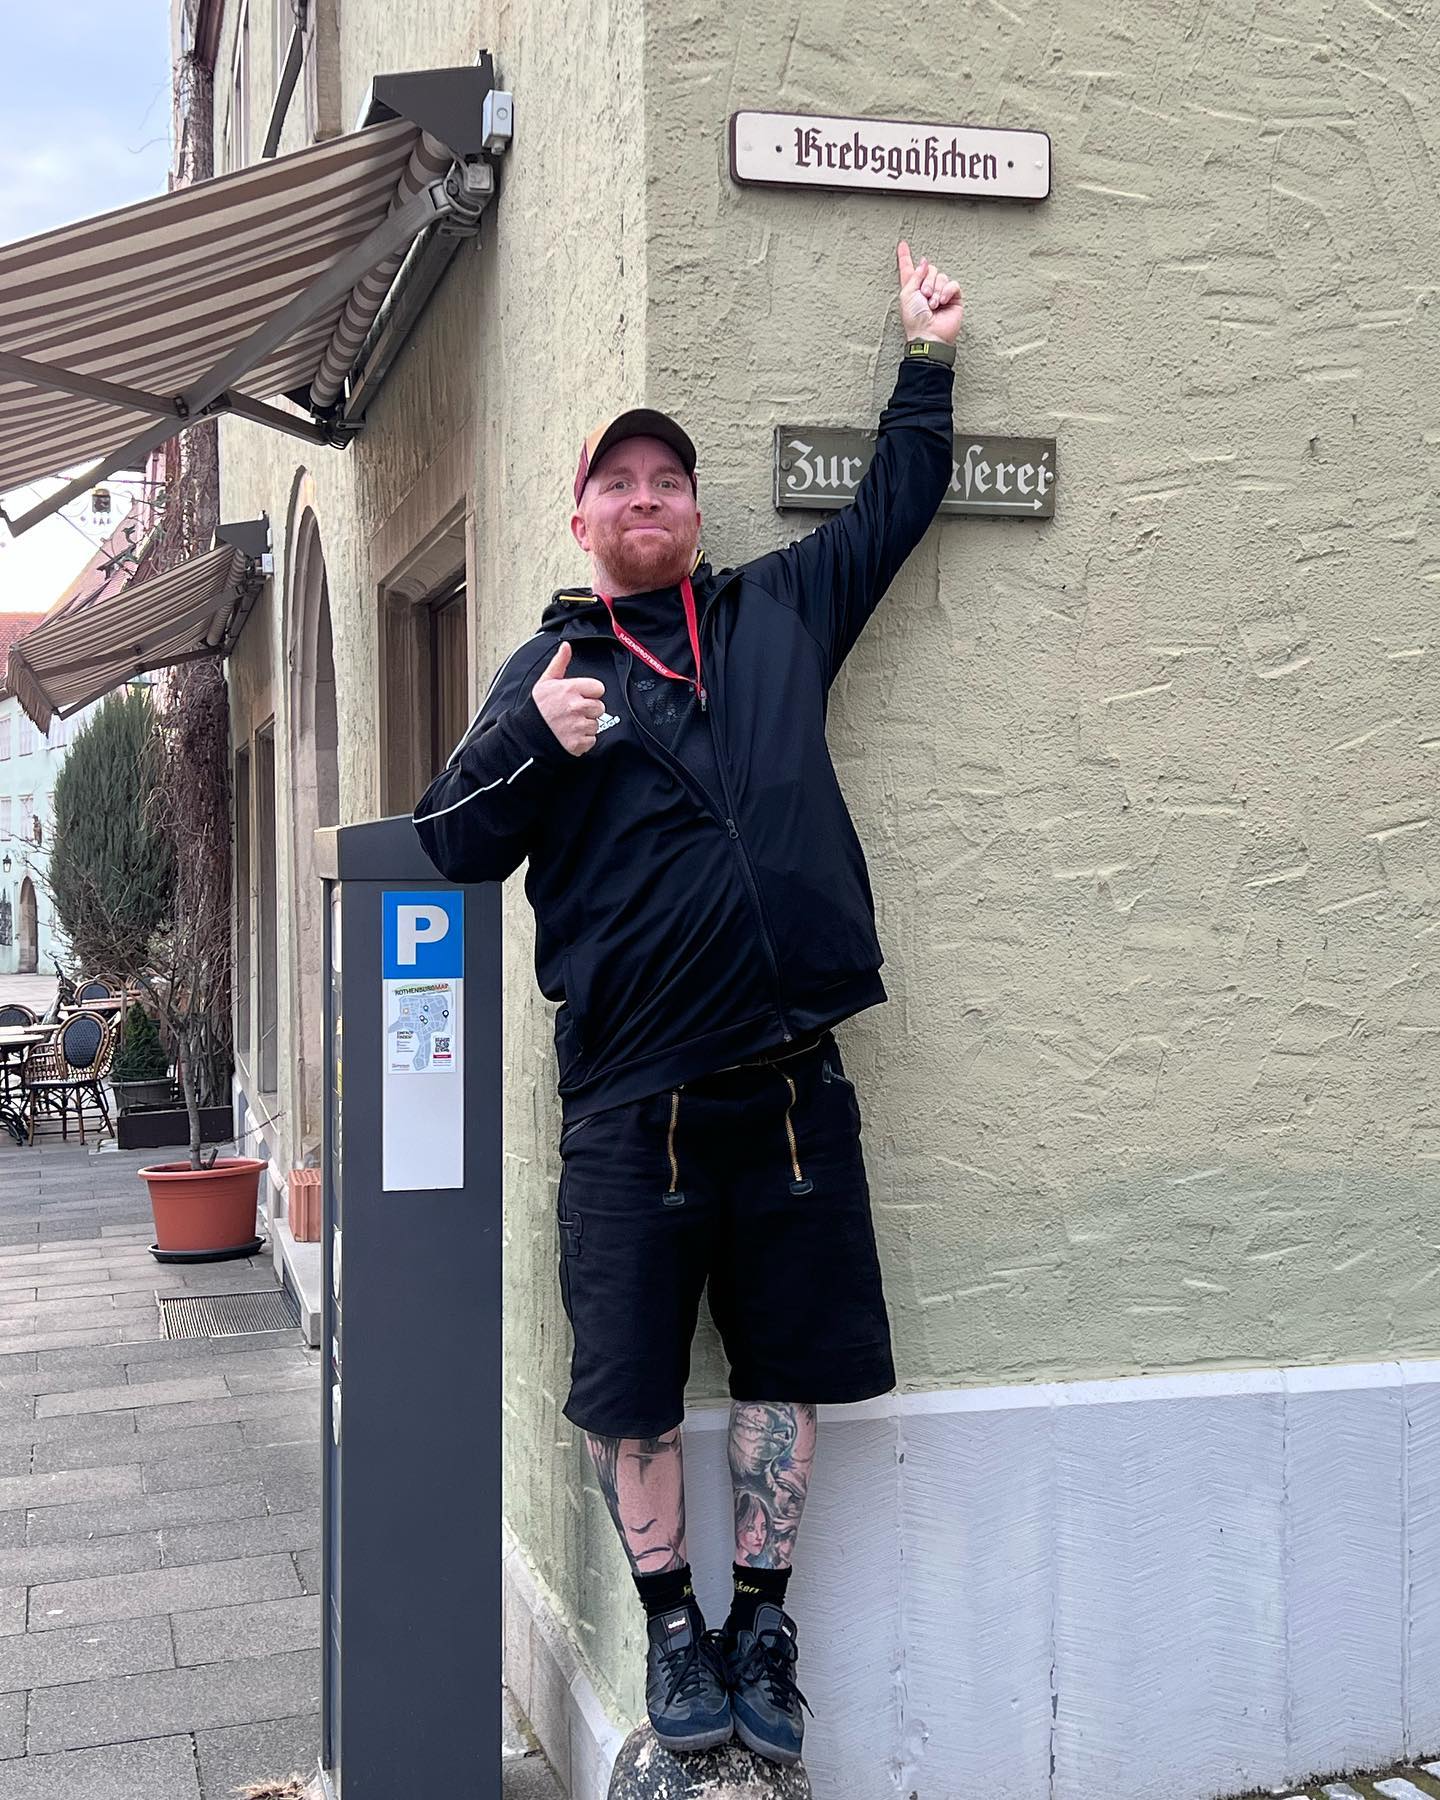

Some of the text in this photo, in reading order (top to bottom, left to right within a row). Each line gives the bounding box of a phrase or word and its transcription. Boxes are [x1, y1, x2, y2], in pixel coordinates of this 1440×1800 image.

[794, 127, 998, 181] Krebsgäßchen
[787, 440, 862, 490] Zur
[397, 905, 450, 965] P
